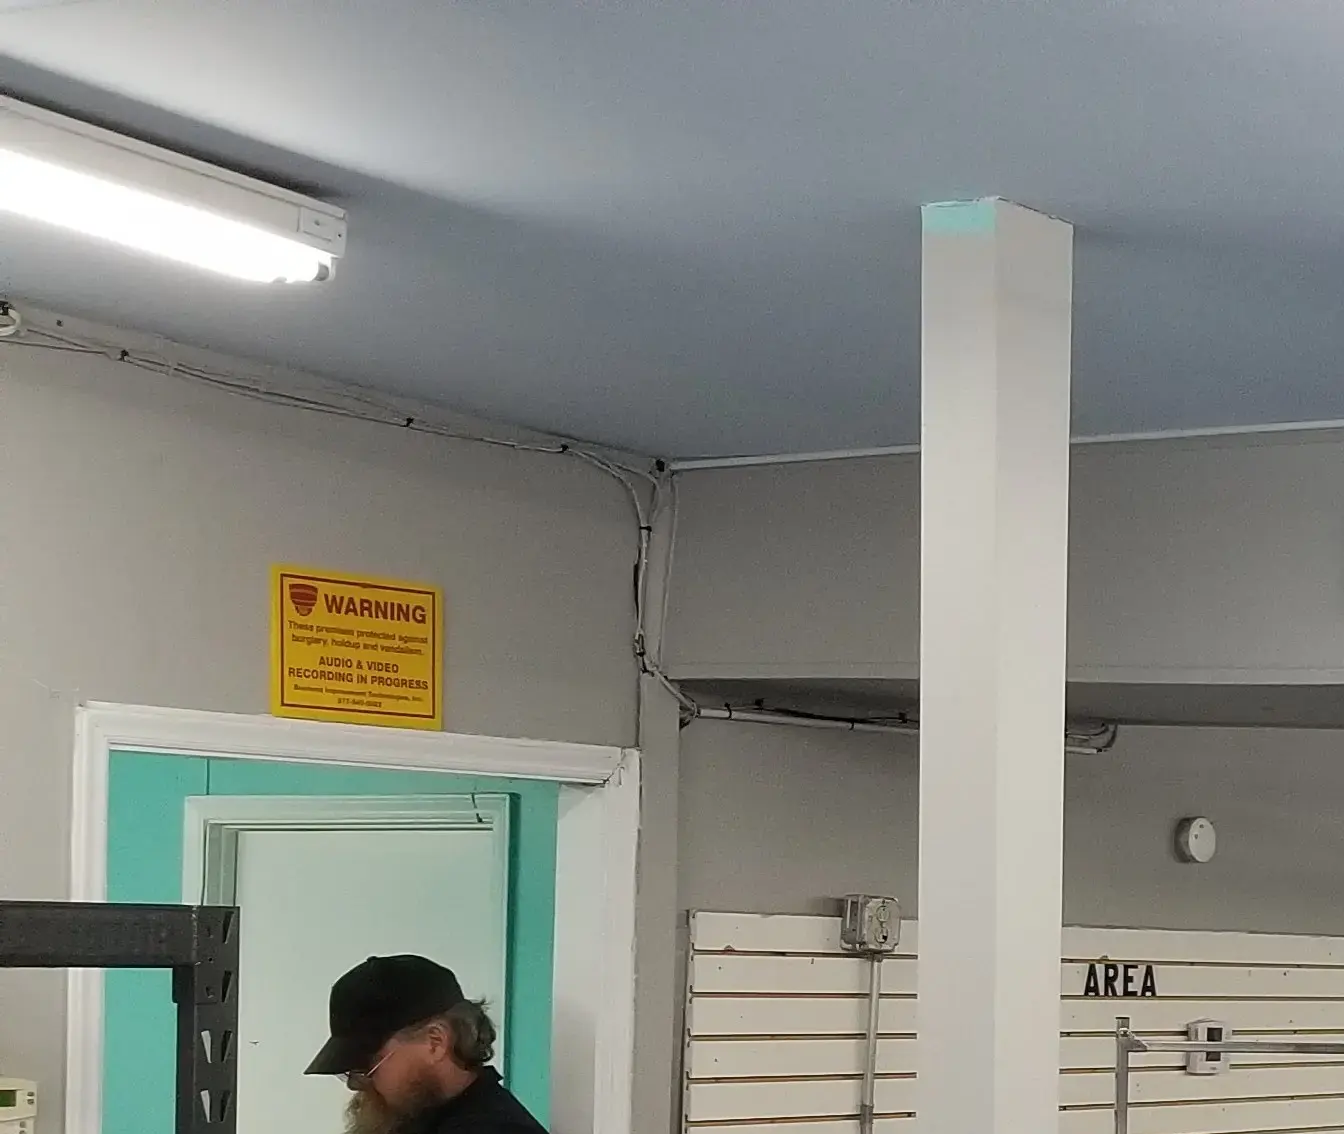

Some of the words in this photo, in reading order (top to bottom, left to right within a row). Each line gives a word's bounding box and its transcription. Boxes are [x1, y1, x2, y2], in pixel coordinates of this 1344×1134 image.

[324, 593, 427, 624] WARNING
[331, 638, 360, 650] holdup
[363, 643, 378, 652] and
[357, 630, 395, 641] protected
[319, 656, 353, 668] AUDIO
[356, 660, 363, 670] &
[366, 661, 399, 673] VIDEO
[288, 667, 353, 683] RECORDING
[357, 674, 367, 684] IN
[371, 675, 428, 690] PROGRESS
[1084, 964, 1157, 996] AREA
